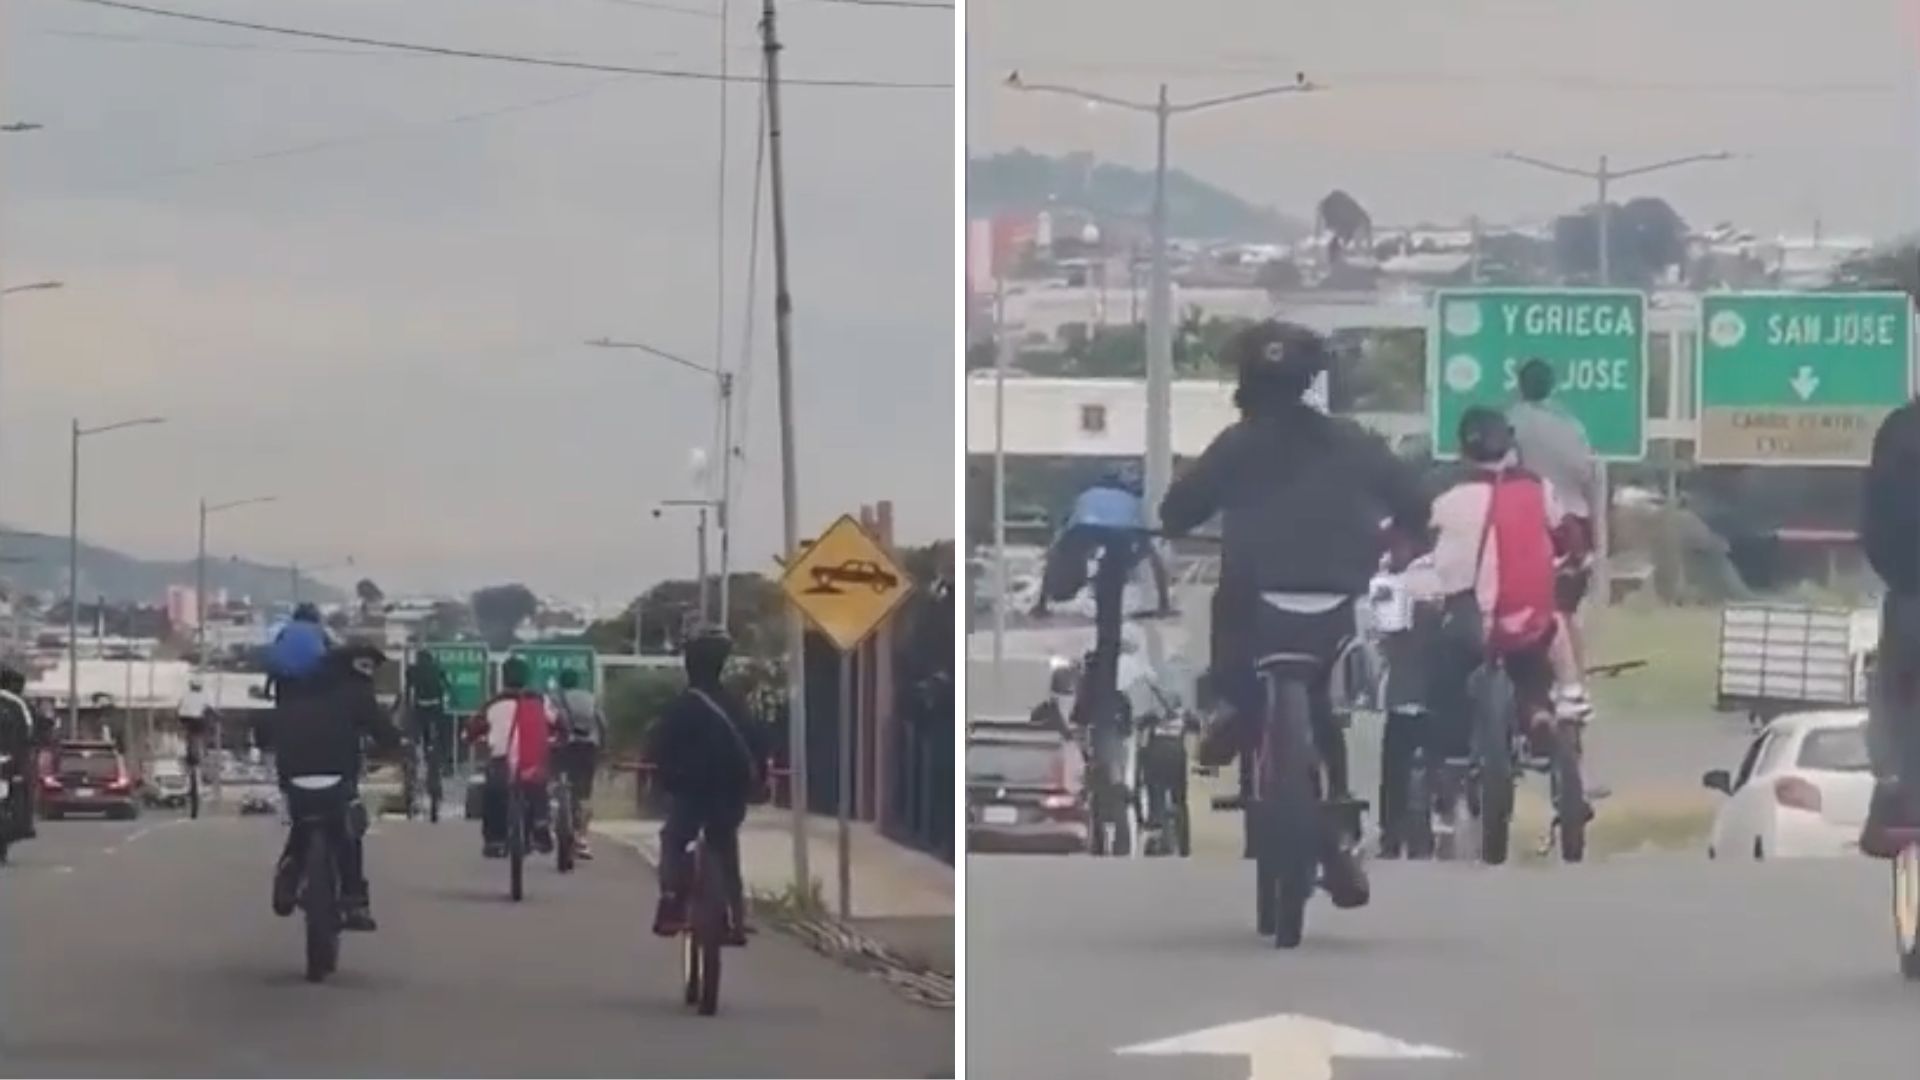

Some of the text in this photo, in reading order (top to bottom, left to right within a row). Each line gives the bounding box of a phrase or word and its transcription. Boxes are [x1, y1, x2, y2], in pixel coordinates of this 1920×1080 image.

[1502, 305, 1519, 334] Y
[1526, 304, 1634, 336] GRIEGA
[1767, 314, 1821, 345] SAN
[1561, 359, 1628, 389] JOSE
